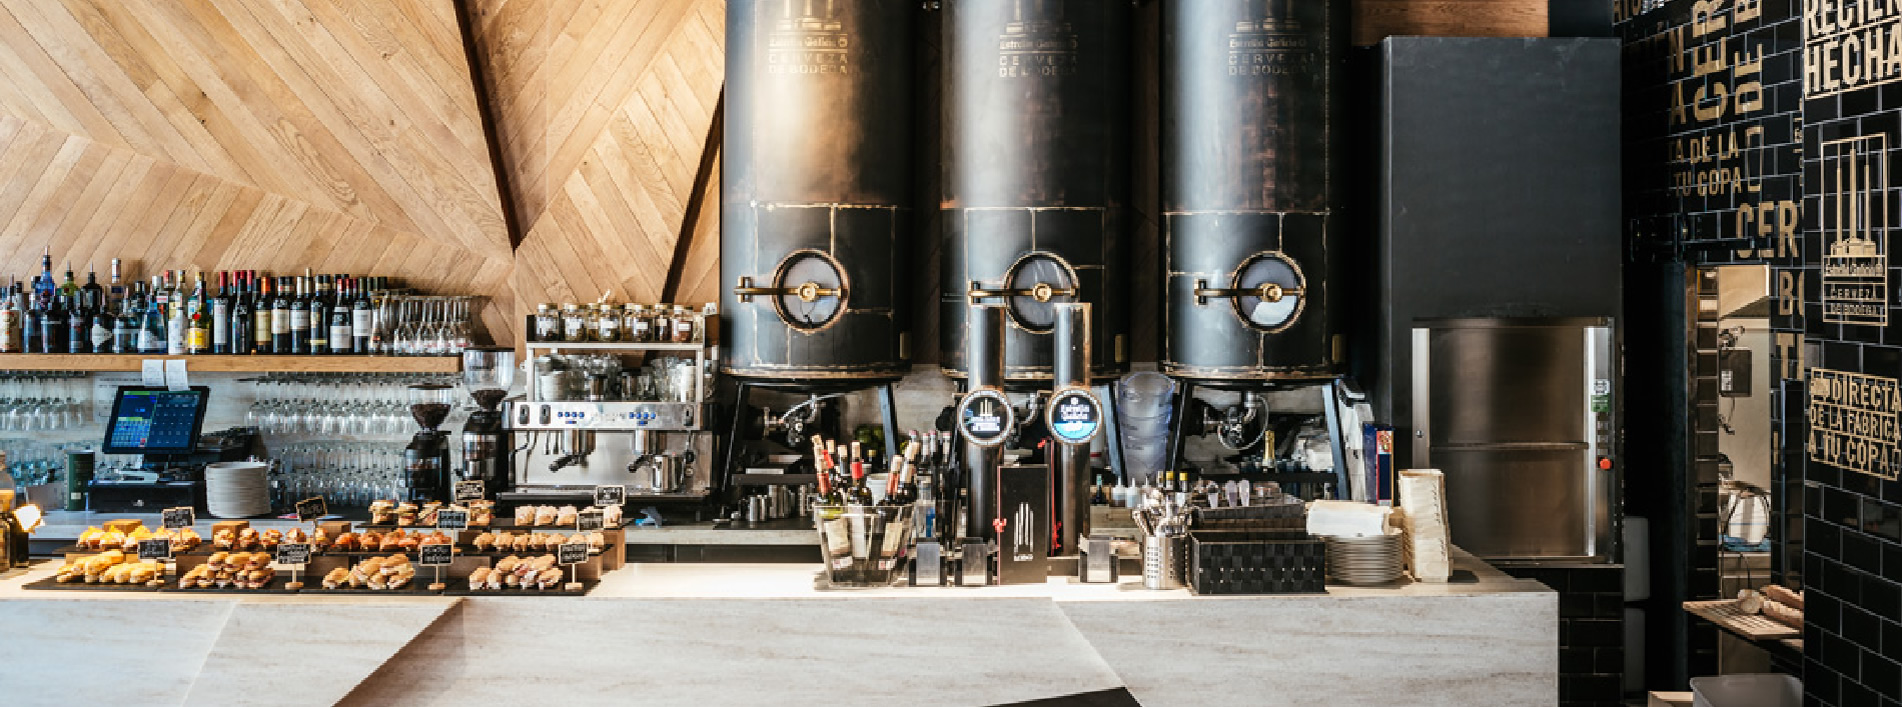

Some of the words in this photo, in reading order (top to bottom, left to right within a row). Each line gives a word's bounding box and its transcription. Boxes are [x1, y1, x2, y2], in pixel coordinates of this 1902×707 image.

[1803, 0, 1902, 40] RECI
[1803, 23, 1902, 94] HECHA
[1735, 44, 1763, 115] DE
[1690, 136, 1713, 165] DE
[1718, 131, 1740, 161] LA
[1673, 169, 1692, 197] TU
[1697, 166, 1743, 197] COPA
[1832, 377, 1902, 412] DIRECTA
[1809, 406, 1825, 425] DE
[1829, 406, 1843, 431] LA
[1808, 429, 1818, 454] A
[1823, 433, 1841, 461] TU
[1846, 440, 1889, 477] COPA
